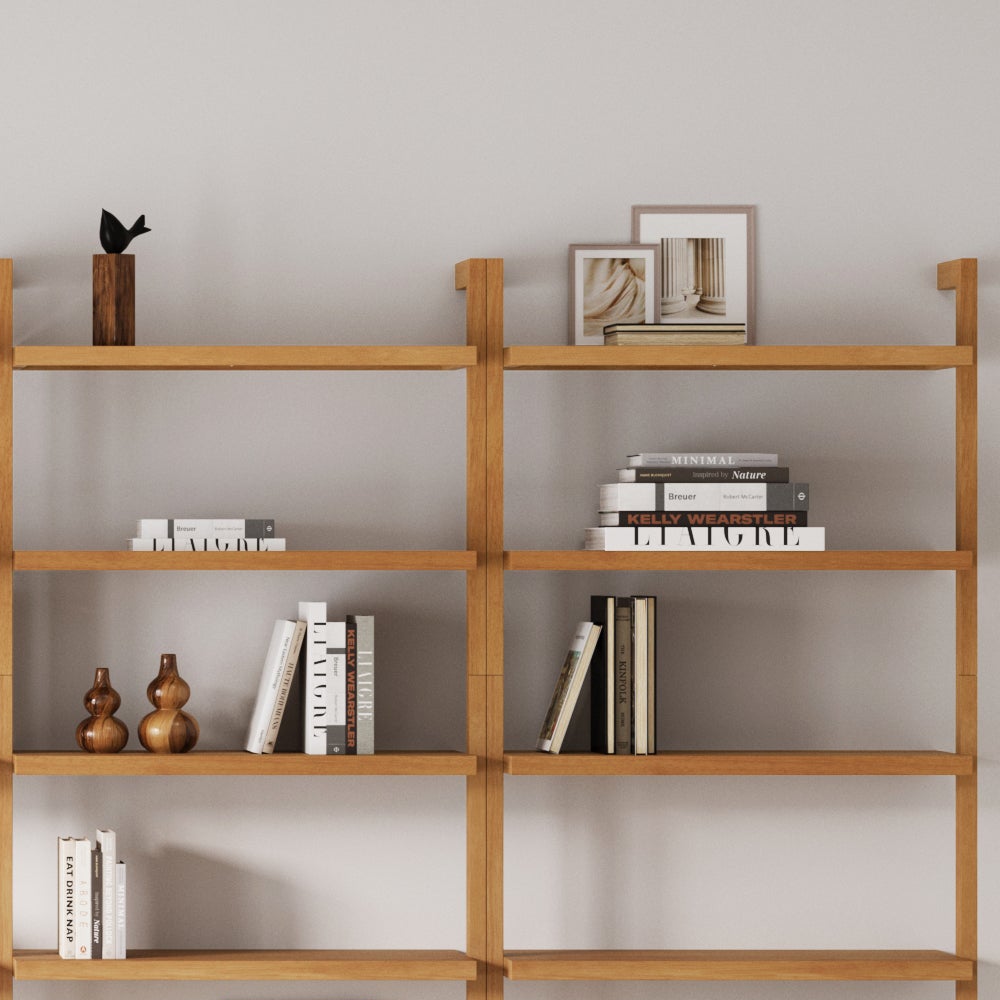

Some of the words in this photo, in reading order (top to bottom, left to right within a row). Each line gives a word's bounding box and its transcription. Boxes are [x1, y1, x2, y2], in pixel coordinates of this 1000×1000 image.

[671, 455, 736, 465] MINIMAL
[692, 471, 719, 479] Inspired
[720, 471, 728, 479] by
[732, 470, 767, 480] Nature
[668, 492, 696, 500] Breuer
[627, 514, 681, 524] KELLY
[687, 514, 797, 524] WEARSTLER
[347, 629, 355, 667] KELLY
[358, 651, 373, 721] LIAIGRE
[619, 660, 627, 704] KINFOLK
[347, 670, 355, 748] WEARSTLER
[66, 856, 74, 877] EAT
[66, 880, 74, 916] DRINK
[66, 919, 74, 943] NAP
[93, 918, 101, 944] Nature
